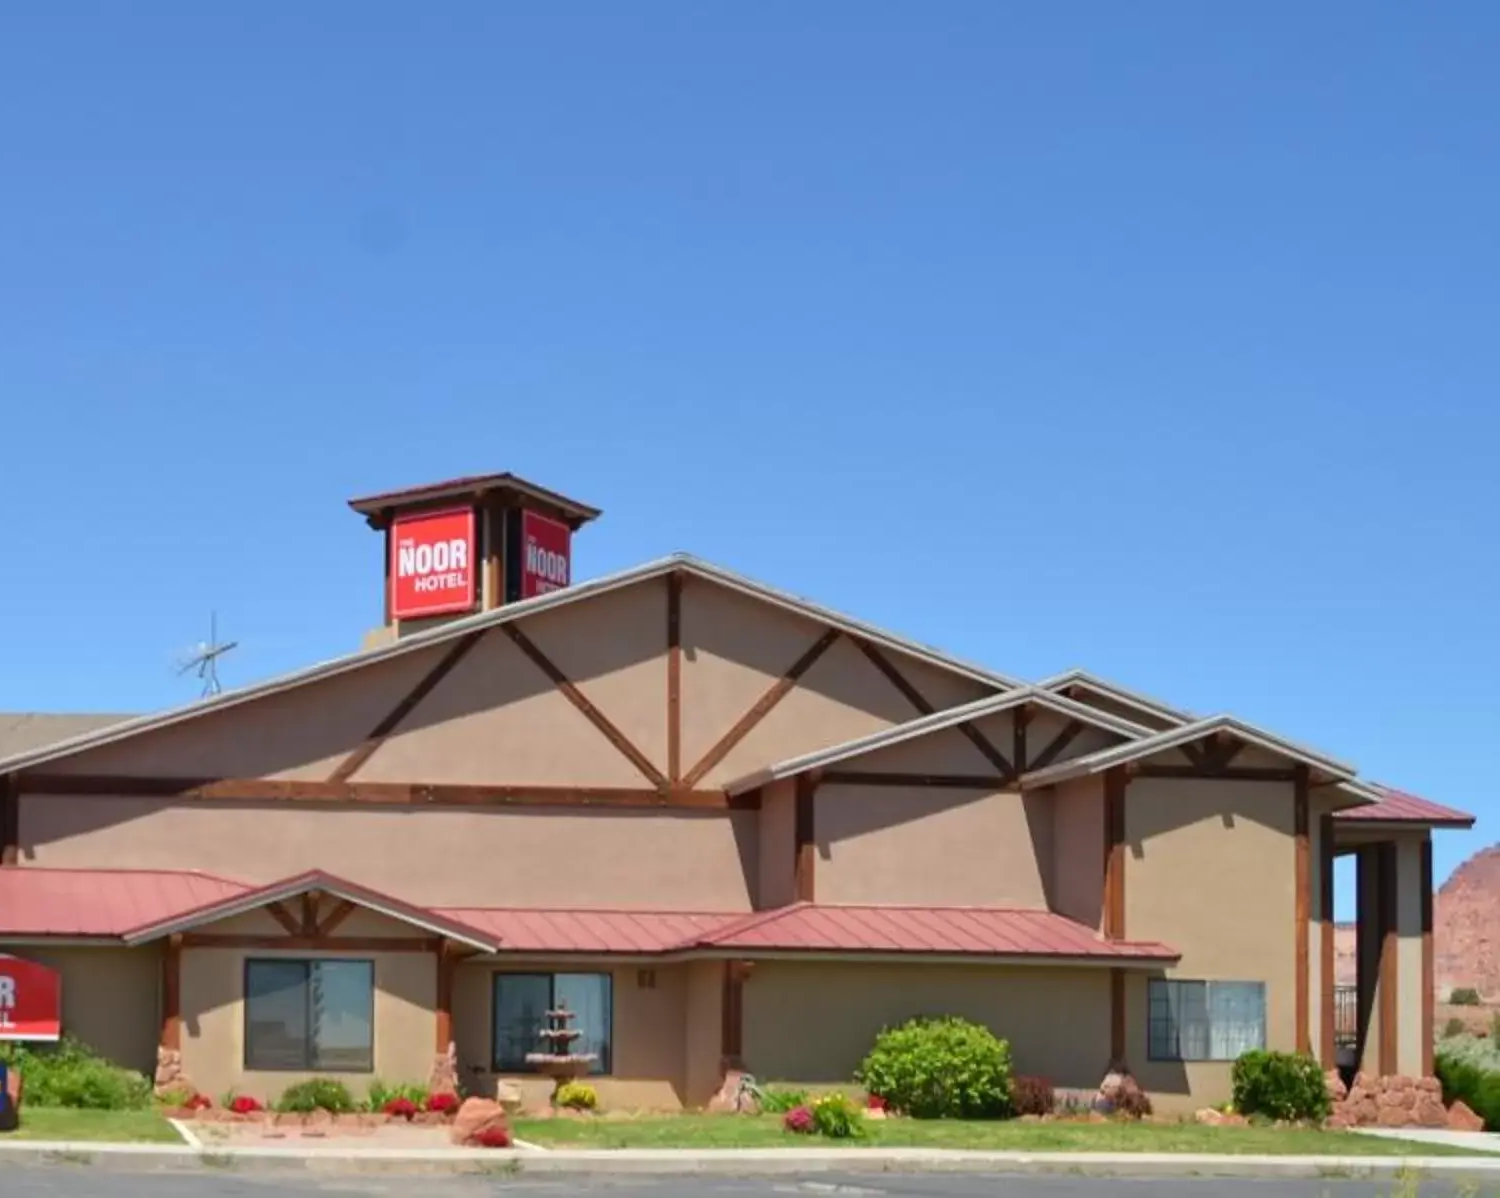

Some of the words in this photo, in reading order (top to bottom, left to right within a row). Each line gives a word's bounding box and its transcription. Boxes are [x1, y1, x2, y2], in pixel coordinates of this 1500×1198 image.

[398, 539, 467, 577] NOOR
[526, 543, 567, 584] NOOR
[415, 573, 467, 592] HOTEL
